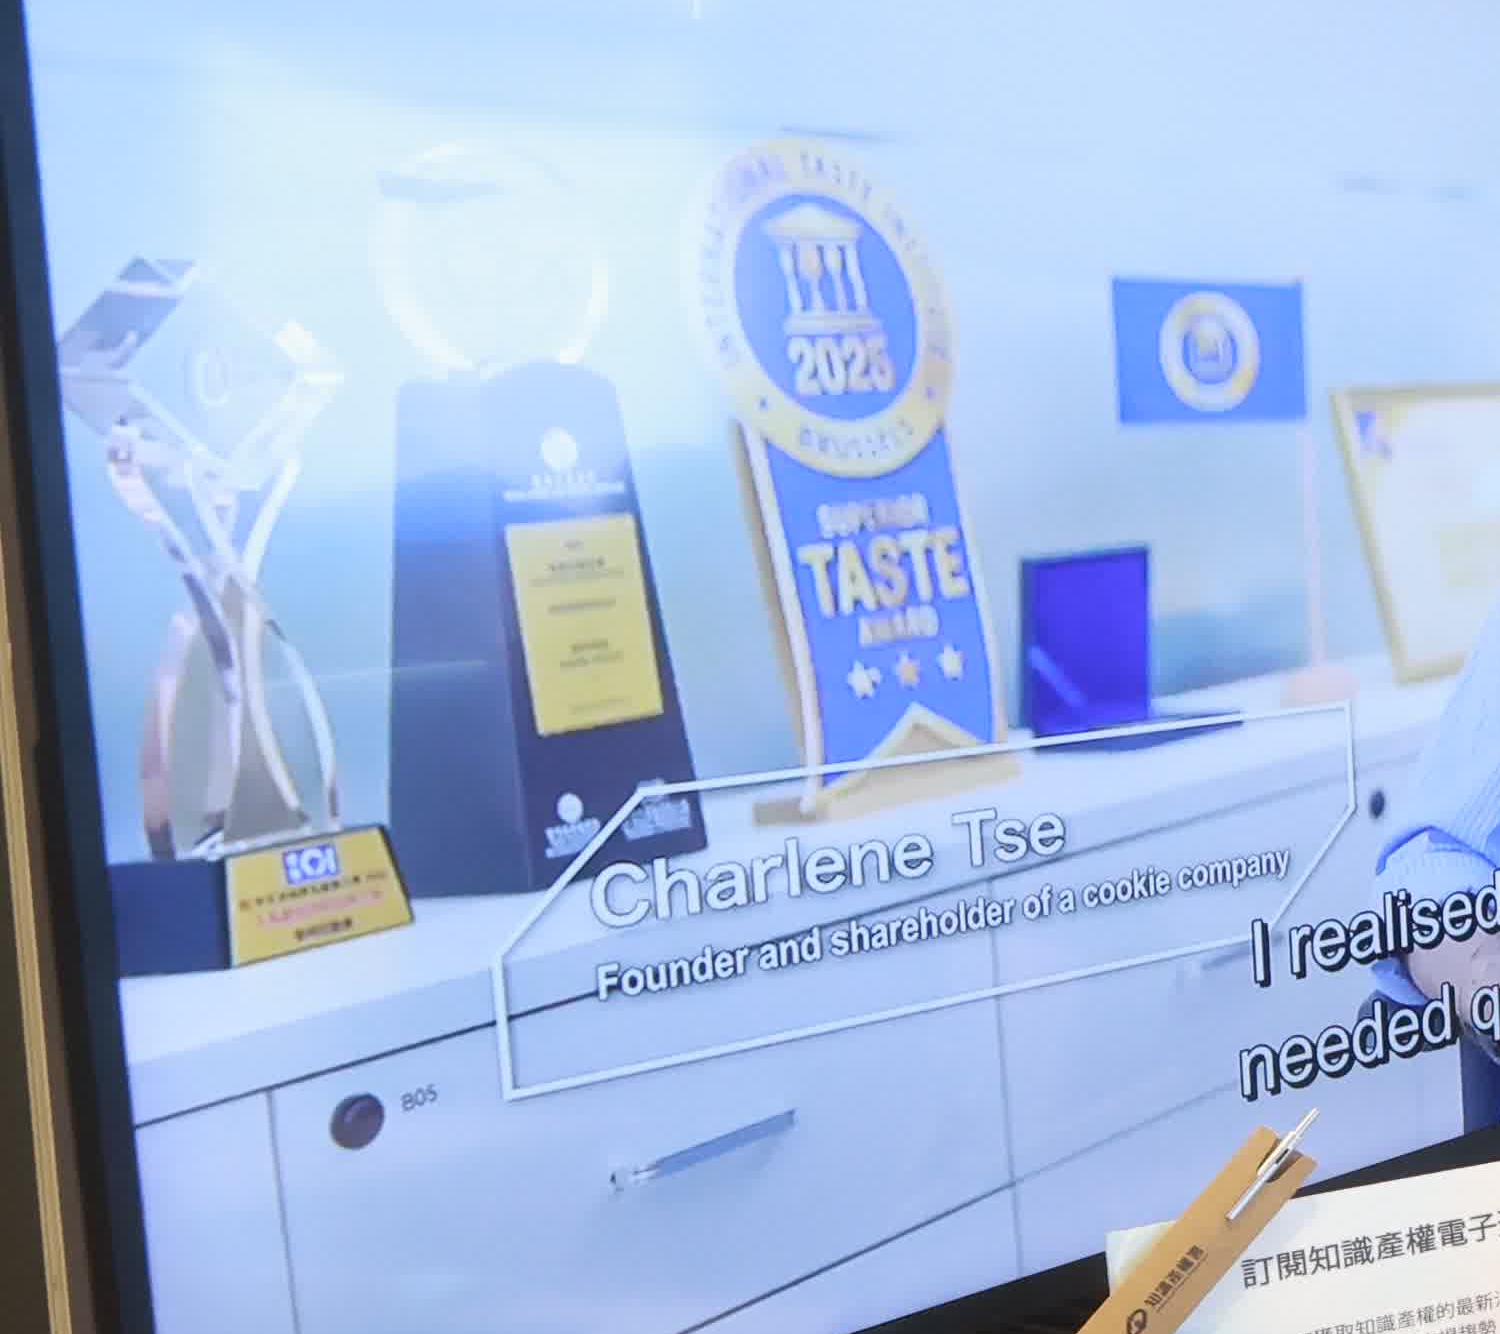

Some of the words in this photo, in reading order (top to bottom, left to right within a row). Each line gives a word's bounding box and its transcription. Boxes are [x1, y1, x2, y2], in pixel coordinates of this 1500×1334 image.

[797, 525, 970, 619] TASTE
[588, 832, 935, 932] Charlene
[951, 806, 1067, 869] Tse
[597, 946, 750, 1001] Founder
[758, 927, 822, 972] and
[829, 891, 1016, 960] shareholder
[1022, 884, 1055, 921] of
[1057, 887, 1076, 913] a
[1081, 867, 1171, 908] cookie
[1177, 848, 1291, 896] company
[1250, 918, 1271, 987] I
[1239, 981, 1460, 1103] needed
